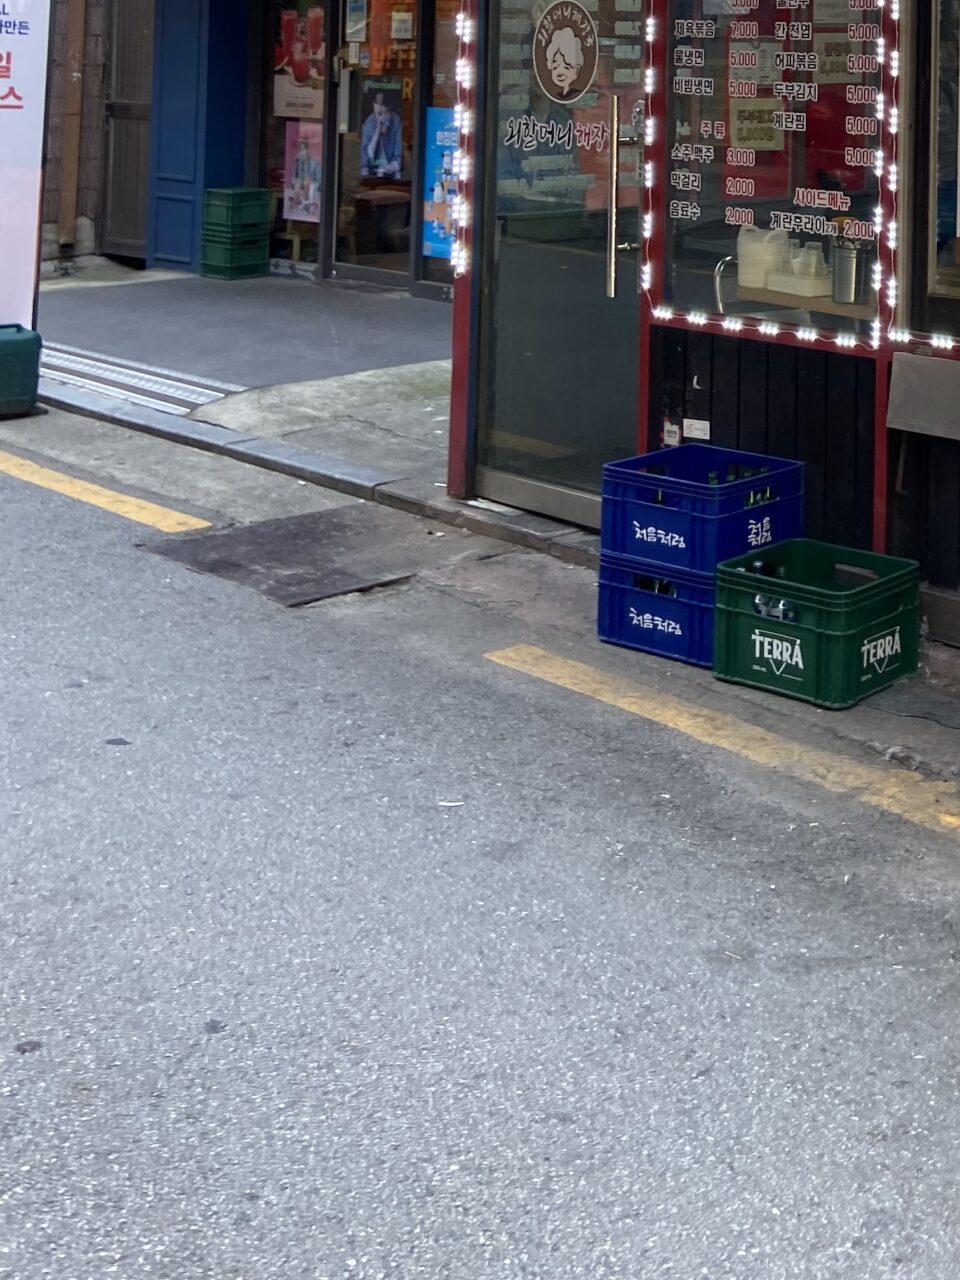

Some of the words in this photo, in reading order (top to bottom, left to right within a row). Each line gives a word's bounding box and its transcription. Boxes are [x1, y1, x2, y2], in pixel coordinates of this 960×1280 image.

[674, 20, 715, 38] 제육볶음
[674, 48, 704, 66] 물냉면
[774, 52, 818, 71] 허파볶음
[673, 77, 714, 95] 비빔냉면
[773, 82, 817, 102] 두부김치
[772, 112, 806, 131] 계란찜
[504, 115, 574, 151] 외할머니
[575, 121, 609, 151] 해장
[671, 172, 701, 191] 막걸리
[793, 188, 851, 211] 사이드메뉴
[670, 200, 700, 220] 음료수
[632, 520, 686, 549] 처음처럼
[629, 607, 683, 636] 처음처럼
[751, 630, 804, 670] TERRA
[861, 628, 902, 668] TERRA
